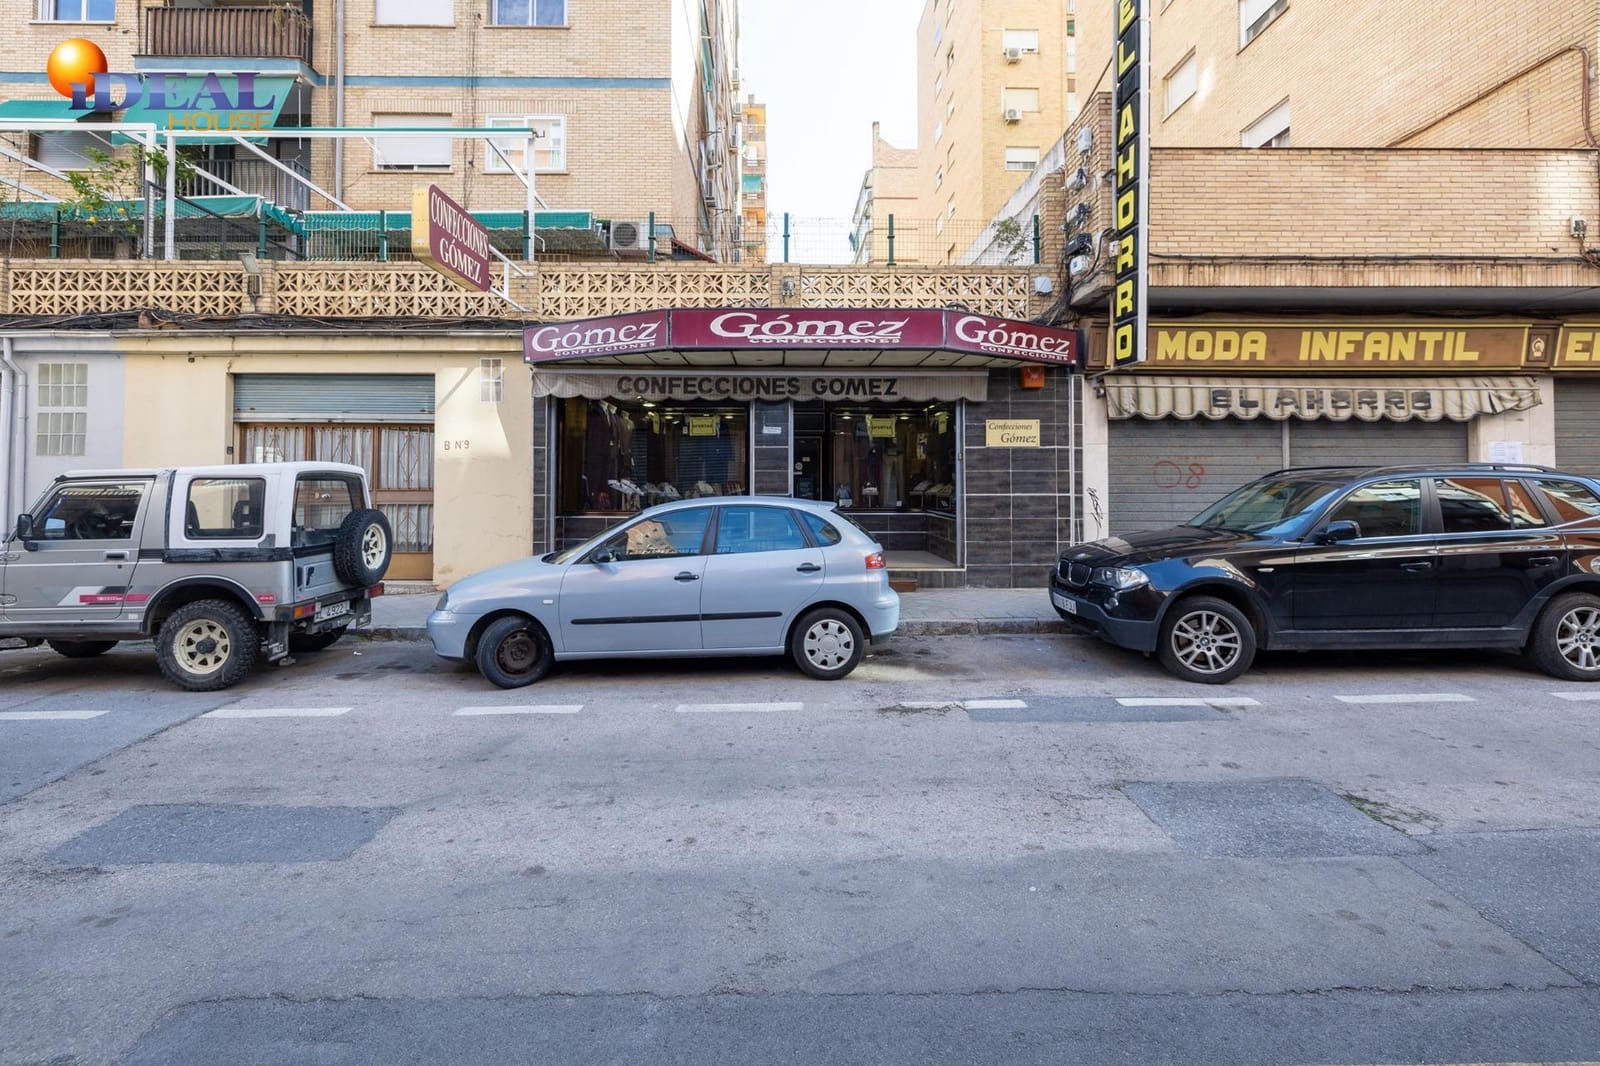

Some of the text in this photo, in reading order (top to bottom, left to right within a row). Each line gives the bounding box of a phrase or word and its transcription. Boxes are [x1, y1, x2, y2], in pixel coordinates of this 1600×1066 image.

[431, 192, 488, 260] CONFECCIONES
[1116, 103, 1136, 360] AHORRO
[440, 238, 482, 284] GÓMEZ
[531, 320, 661, 352] Gómez
[710, 312, 910, 340] Gómez
[955, 316, 1070, 355] Gómez
[554, 341, 655, 357] CONFECCIONES
[980, 345, 1069, 360] CONFECCIONES
[1156, 331, 1479, 361] MODA INFANTIL
[617, 376, 898, 396] CONFECCIONES GOMEZ
[988, 422, 1033, 432] Confecciones
[1000, 432, 1037, 444] Gómez
